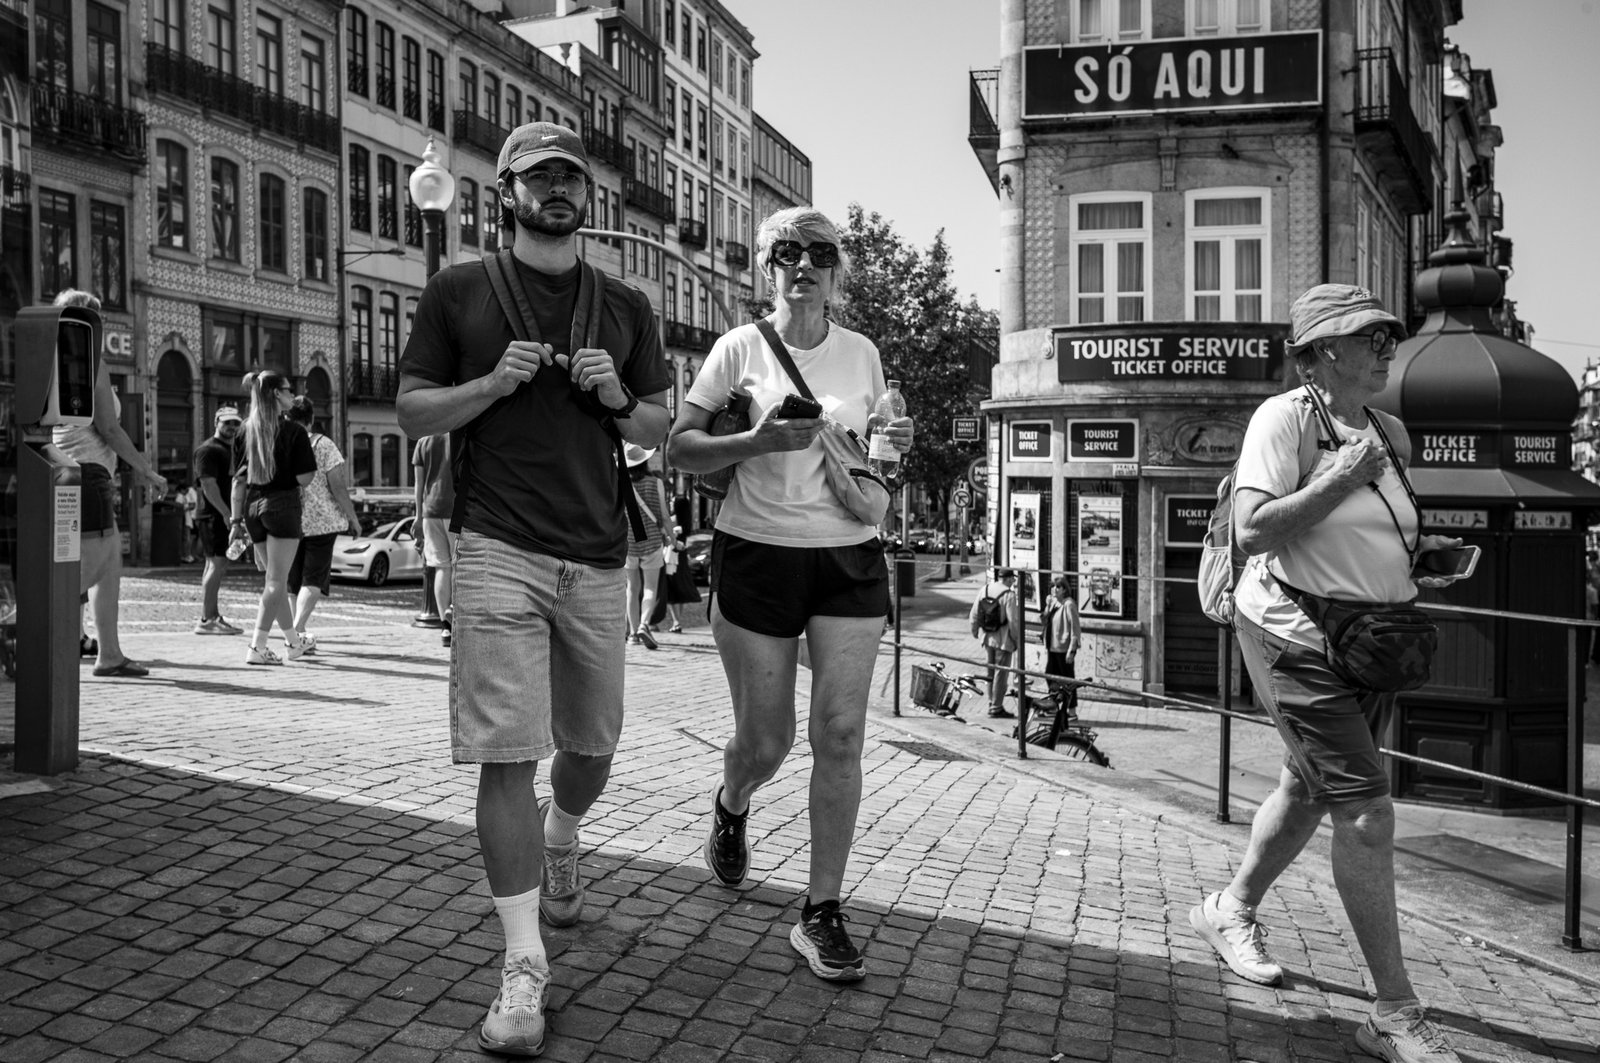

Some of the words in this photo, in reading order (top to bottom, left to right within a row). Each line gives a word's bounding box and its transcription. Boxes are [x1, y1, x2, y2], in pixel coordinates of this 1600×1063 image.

[1074, 46, 1133, 104] SÓ
[1153, 47, 1264, 99] AQUI
[1071, 338, 1163, 359] TOURIST
[1178, 337, 1269, 358] SERVICE
[1111, 360, 1166, 375] TICKET
[1171, 360, 1227, 374] OFFICE
[1018, 431, 1038, 440] TICKET
[1084, 429, 1119, 439] TOURIST
[1018, 441, 1038, 451] OFFICE
[1084, 441, 1118, 451] SERVICE
[1210, 443, 1236, 453] travel
[1422, 435, 1477, 449] TICKET
[1513, 436, 1556, 449] TOURIST
[1422, 449, 1477, 462] OFFICE
[1514, 450, 1556, 464] SERVICE
[1176, 509, 1208, 518] TICKET
